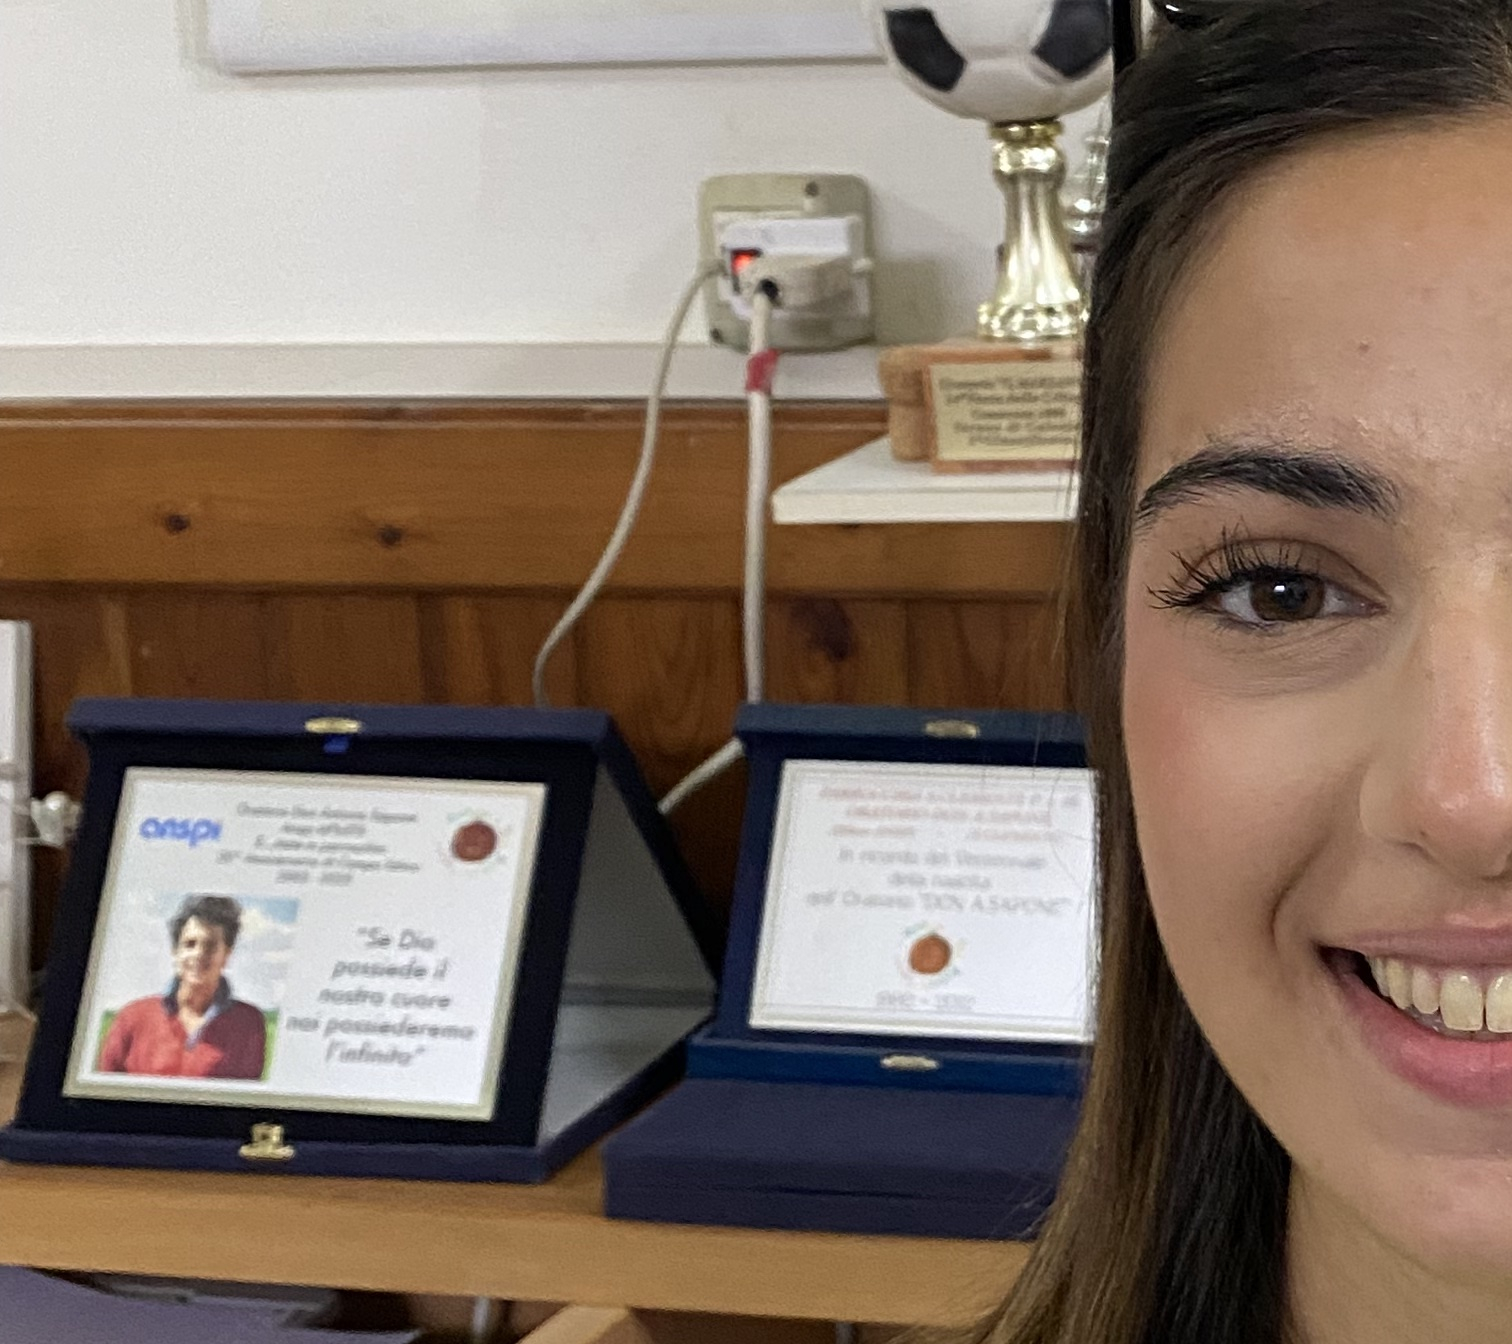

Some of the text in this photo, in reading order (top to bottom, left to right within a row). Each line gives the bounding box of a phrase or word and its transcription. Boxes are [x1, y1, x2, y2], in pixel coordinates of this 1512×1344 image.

[139, 817, 222, 847] anspi
[398, 928, 435, 950] Dio
[331, 957, 448, 980] possiede il
[318, 987, 450, 1010] nostro cuore
[286, 1014, 476, 1041] noi possiederemo
